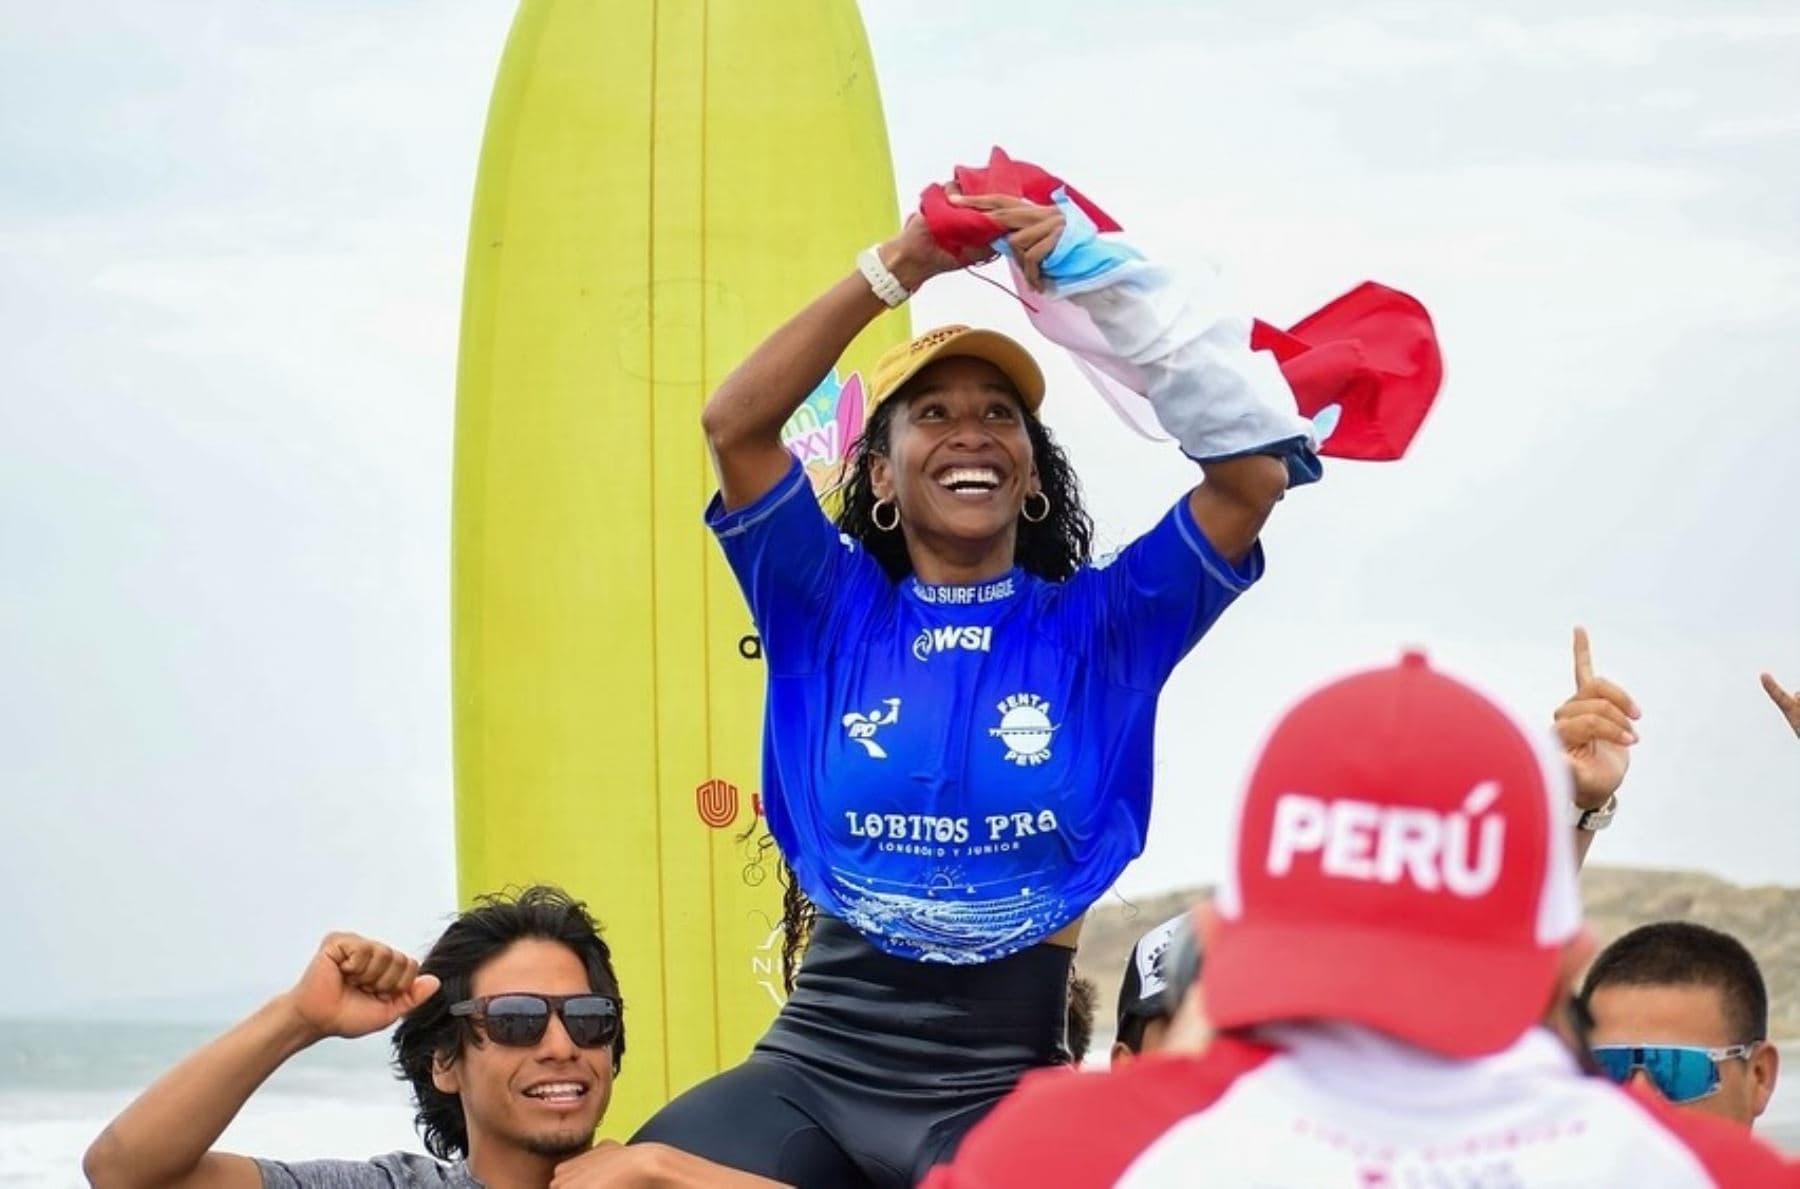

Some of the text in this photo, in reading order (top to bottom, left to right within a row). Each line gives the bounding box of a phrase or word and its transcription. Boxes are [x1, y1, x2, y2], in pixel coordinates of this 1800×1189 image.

[937, 586, 976, 604] SURF
[1004, 748, 1053, 768] PERU
[845, 809, 1058, 844] LOBITOS PRO
[952, 847, 961, 858] Y
[967, 841, 1021, 856] JUNIOR
[1266, 779, 1507, 900] PERÚ
